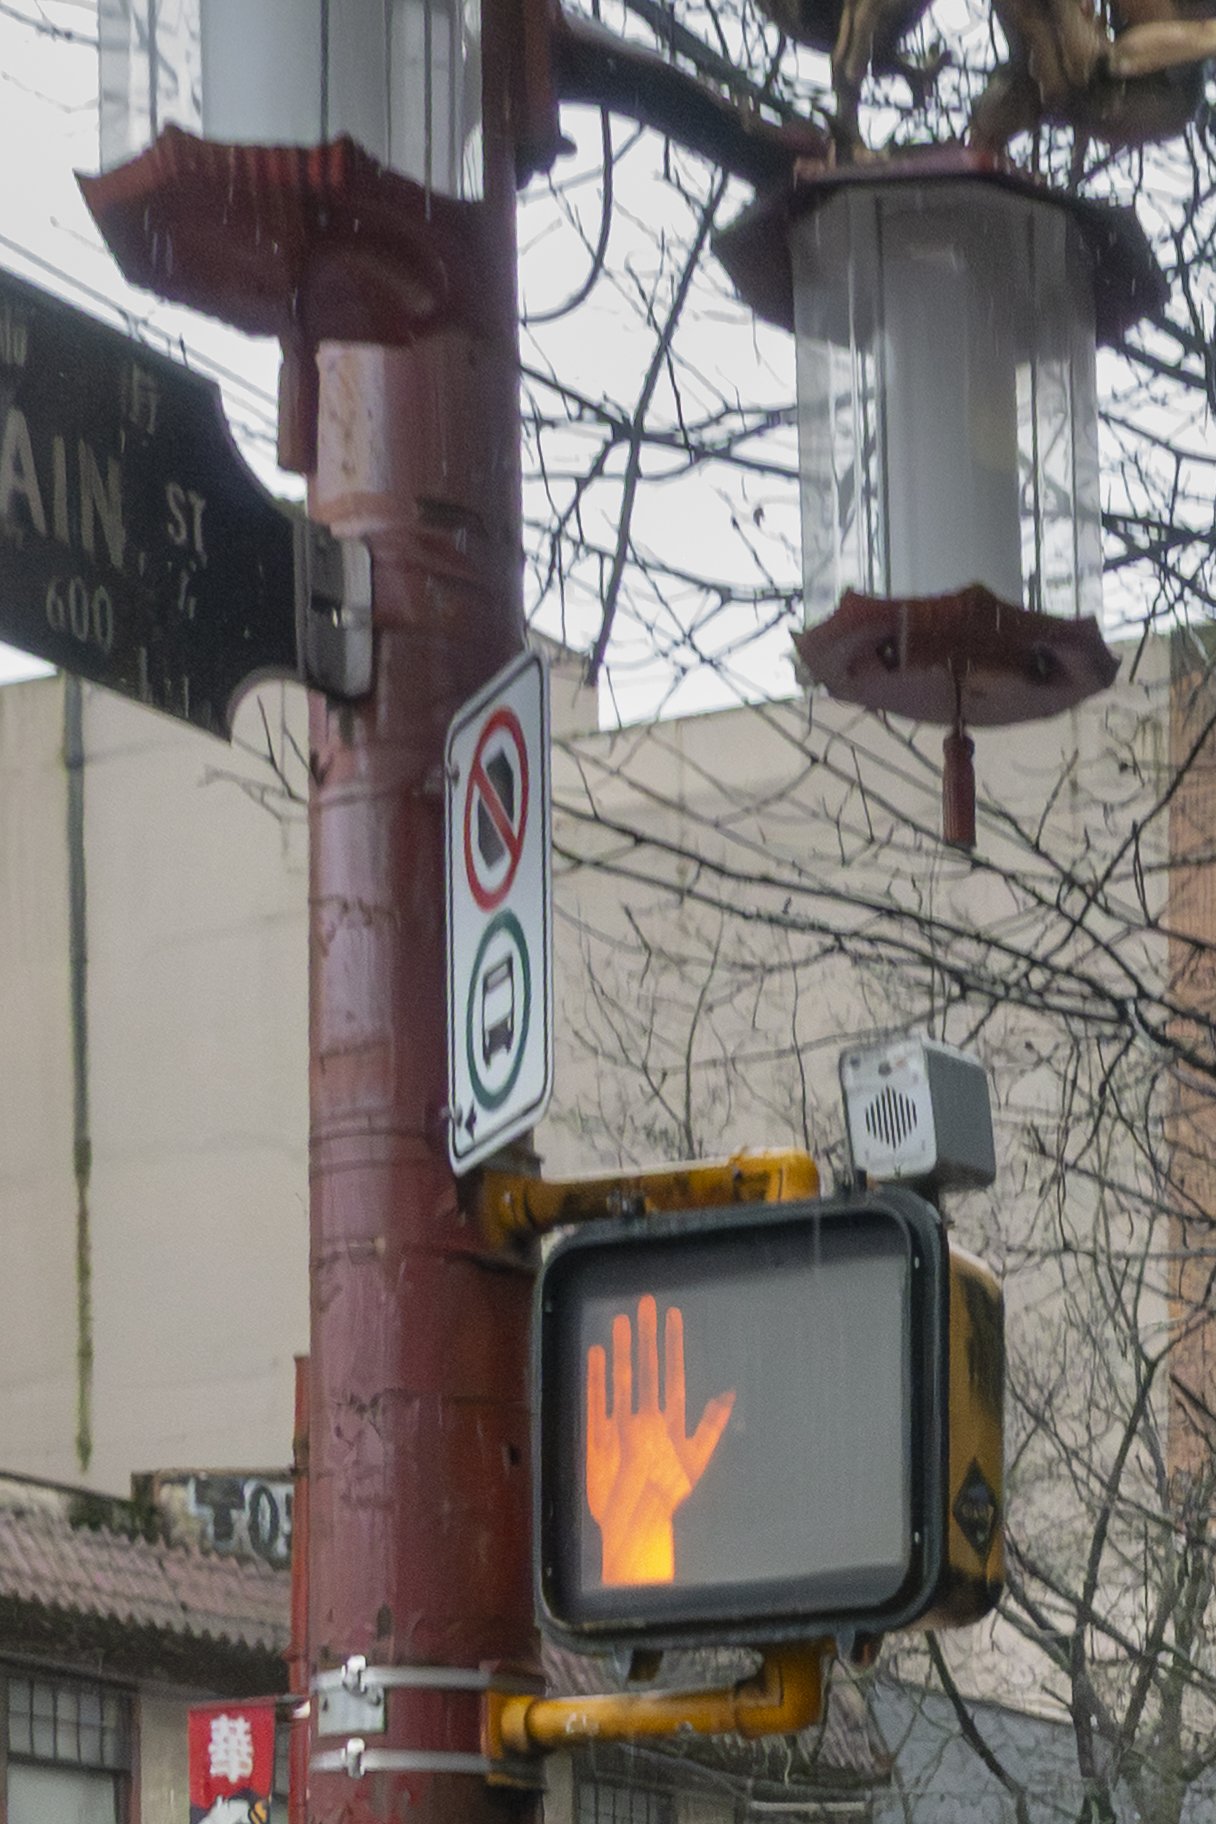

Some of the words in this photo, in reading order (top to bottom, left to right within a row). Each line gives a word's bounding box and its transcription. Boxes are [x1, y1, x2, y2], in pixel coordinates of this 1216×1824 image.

[0, 405, 126, 573] AIN
[165, 480, 208, 567] ST
[45, 575, 115, 654] 600
